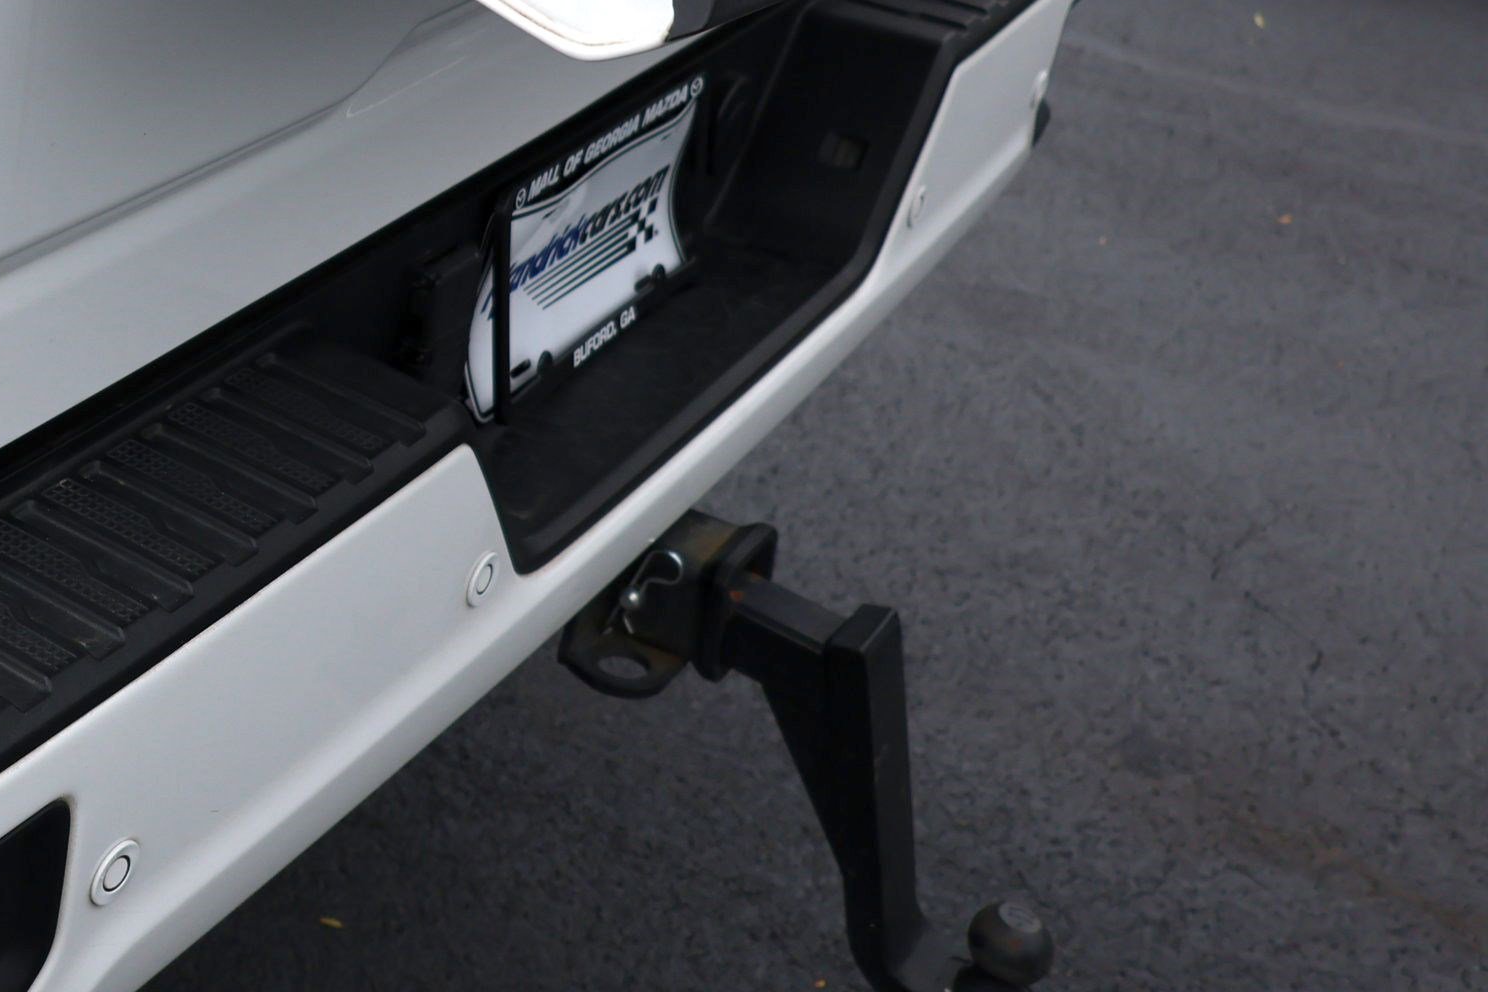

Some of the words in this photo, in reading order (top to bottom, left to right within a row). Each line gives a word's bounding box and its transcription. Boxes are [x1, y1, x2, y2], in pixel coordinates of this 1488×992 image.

[528, 163, 561, 201] MALL
[563, 148, 584, 177] OF
[584, 113, 641, 164] GEORGIA
[642, 84, 688, 127] MAZDA
[573, 321, 617, 368] BUFORD,
[620, 305, 636, 329] GA
